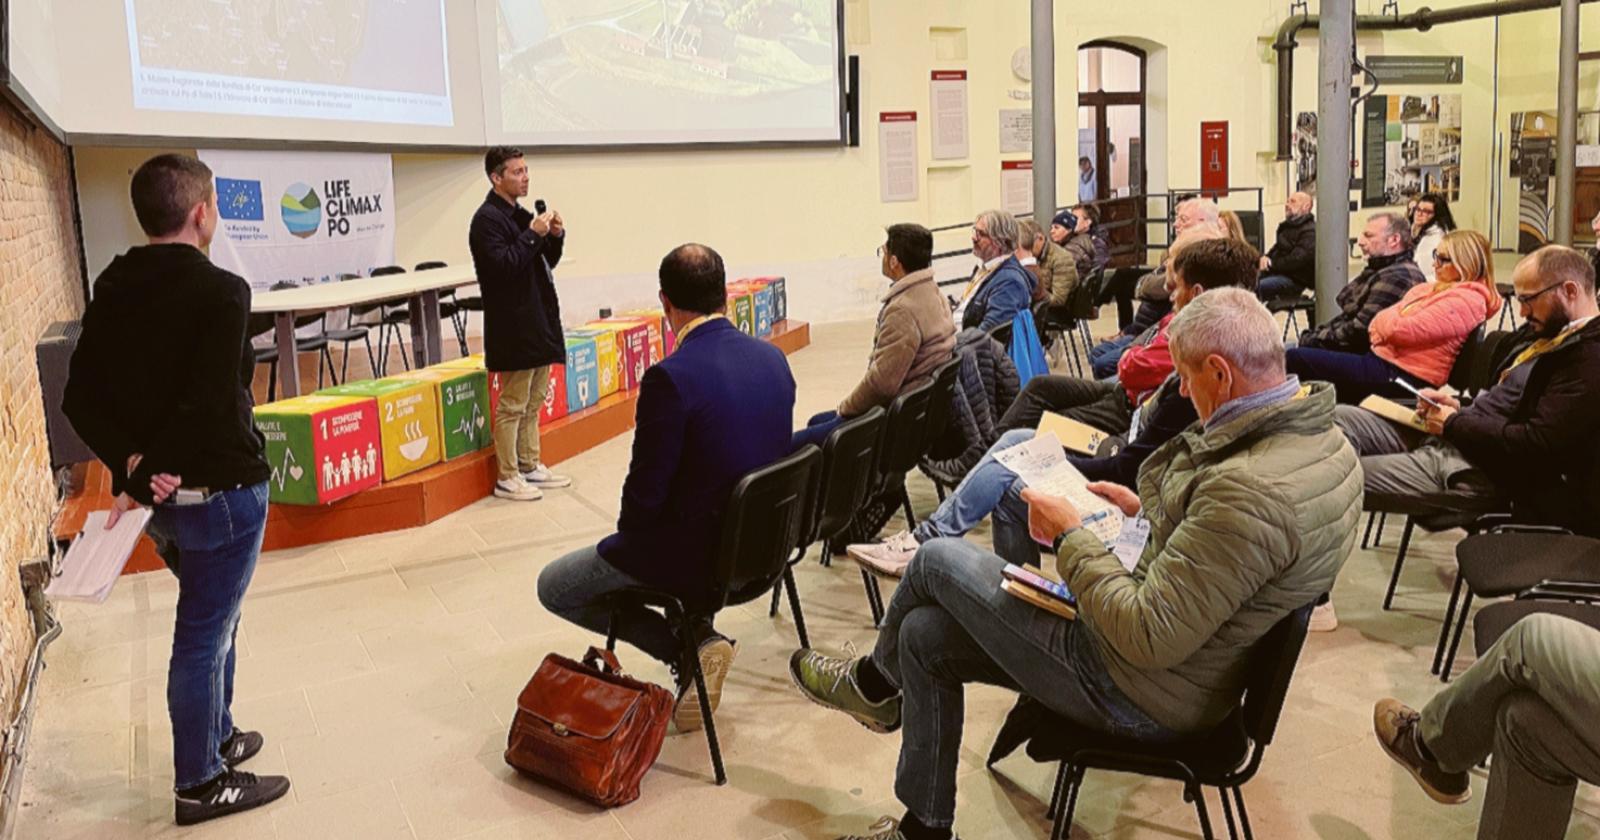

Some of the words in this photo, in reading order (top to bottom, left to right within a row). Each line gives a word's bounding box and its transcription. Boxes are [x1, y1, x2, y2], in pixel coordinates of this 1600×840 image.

[324, 179, 351, 198] LIFE
[326, 193, 382, 217] CLIMAX
[328, 217, 350, 238] PO
[492, 373, 500, 391] 4
[446, 386, 454, 406] 3
[385, 402, 394, 423] 2
[320, 417, 328, 440] 1
[218, 787, 241, 804] N
